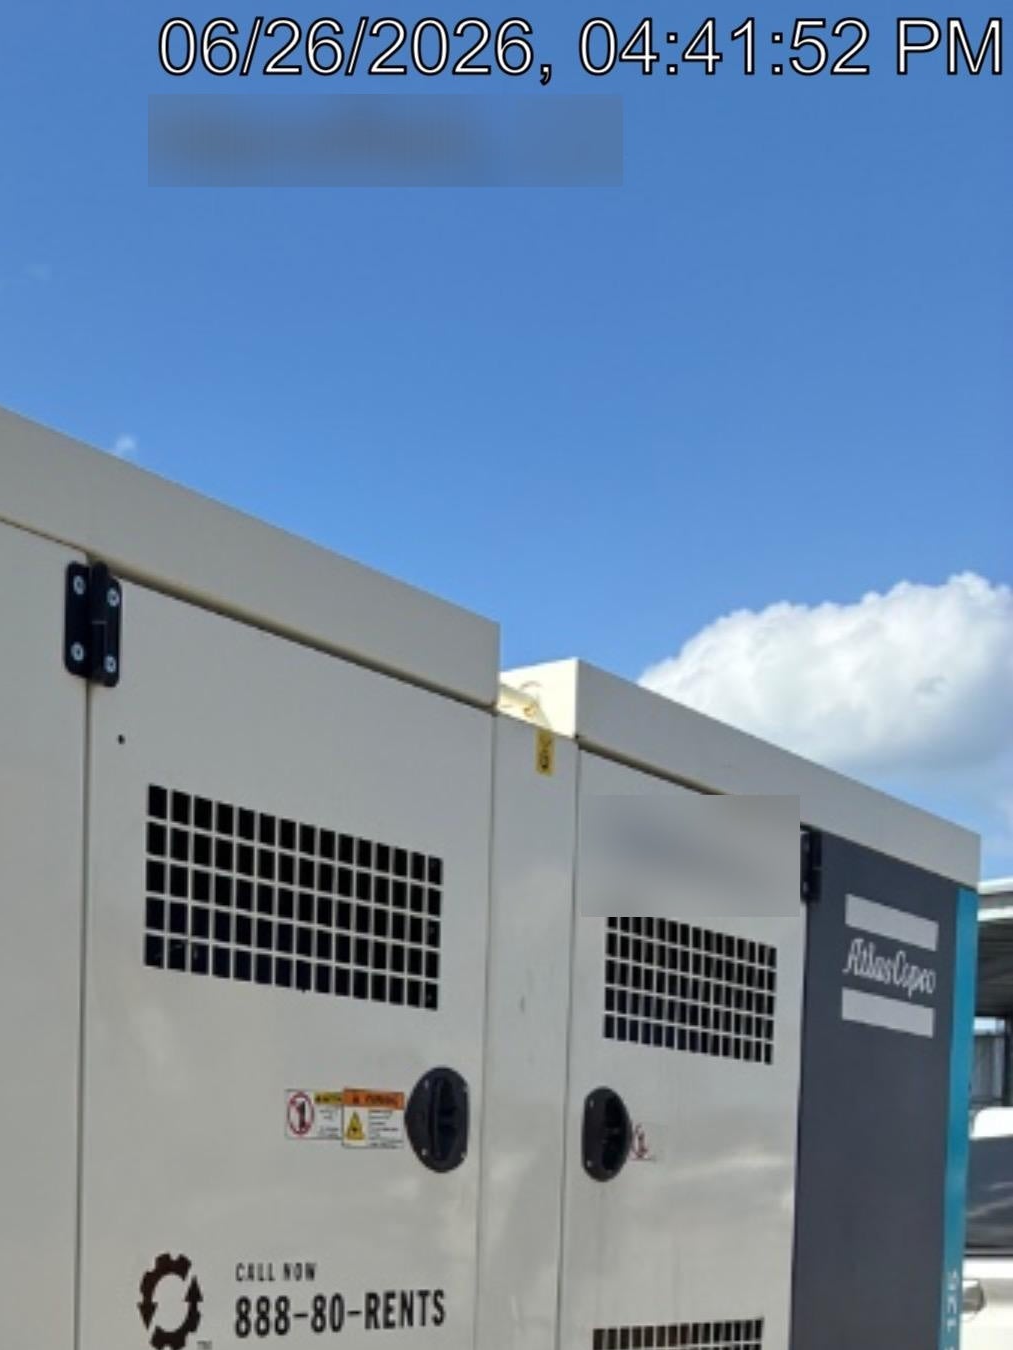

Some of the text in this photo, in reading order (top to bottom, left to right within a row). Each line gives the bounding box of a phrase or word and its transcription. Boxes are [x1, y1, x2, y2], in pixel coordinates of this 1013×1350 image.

[235, 1263, 317, 1282] CALL NOW
[235, 1289, 446, 1339] 888-80-RENTS
